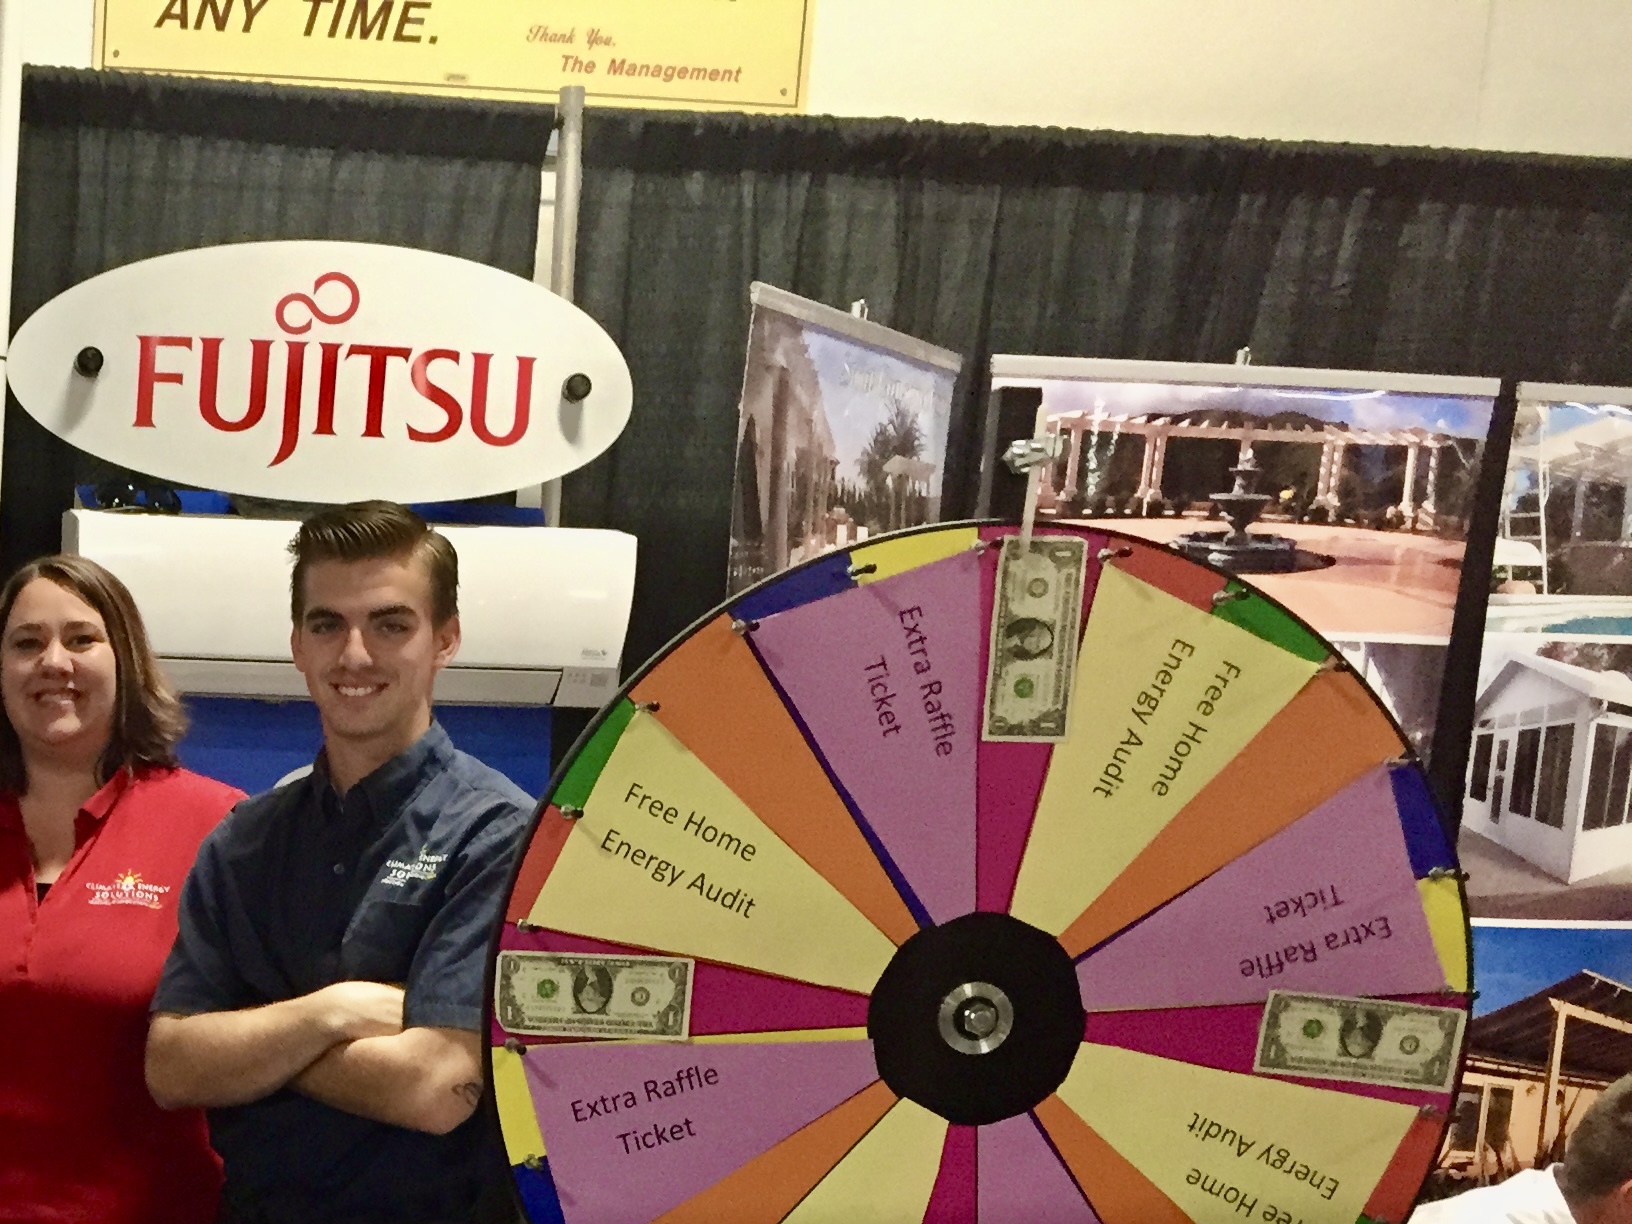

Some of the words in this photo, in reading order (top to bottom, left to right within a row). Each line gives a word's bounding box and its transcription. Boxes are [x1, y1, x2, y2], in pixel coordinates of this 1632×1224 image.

[154, 0, 275, 33] ANY
[303, 0, 438, 45] TIME.
[526, 24, 575, 45] Thank
[561, 54, 596, 74] The
[607, 58, 743, 83] Management
[132, 333, 538, 468] FUJITSU
[865, 655, 902, 738] Ticket
[898, 605, 931, 676] Extra
[920, 680, 956, 758] Raffle
[1133, 638, 1195, 726] Energy
[1196, 660, 1241, 718] Free
[1093, 728, 1144, 798] Audit
[1151, 723, 1208, 798] Home
[624, 783, 678, 824] Free
[683, 811, 757, 862] Home
[601, 829, 685, 887] Energy
[686, 873, 756, 919] Audit
[1264, 884, 1344, 924] Ticket
[1239, 940, 1318, 979] Raffle
[1324, 916, 1392, 951] Extra
[571, 1091, 637, 1122] Extra
[643, 1065, 719, 1102] Raffle
[615, 1118, 696, 1154] Ticket
[1187, 1112, 1256, 1157] Audit
[1186, 1168, 1258, 1217] Home
[1256, 1144, 1340, 1200] Energy
